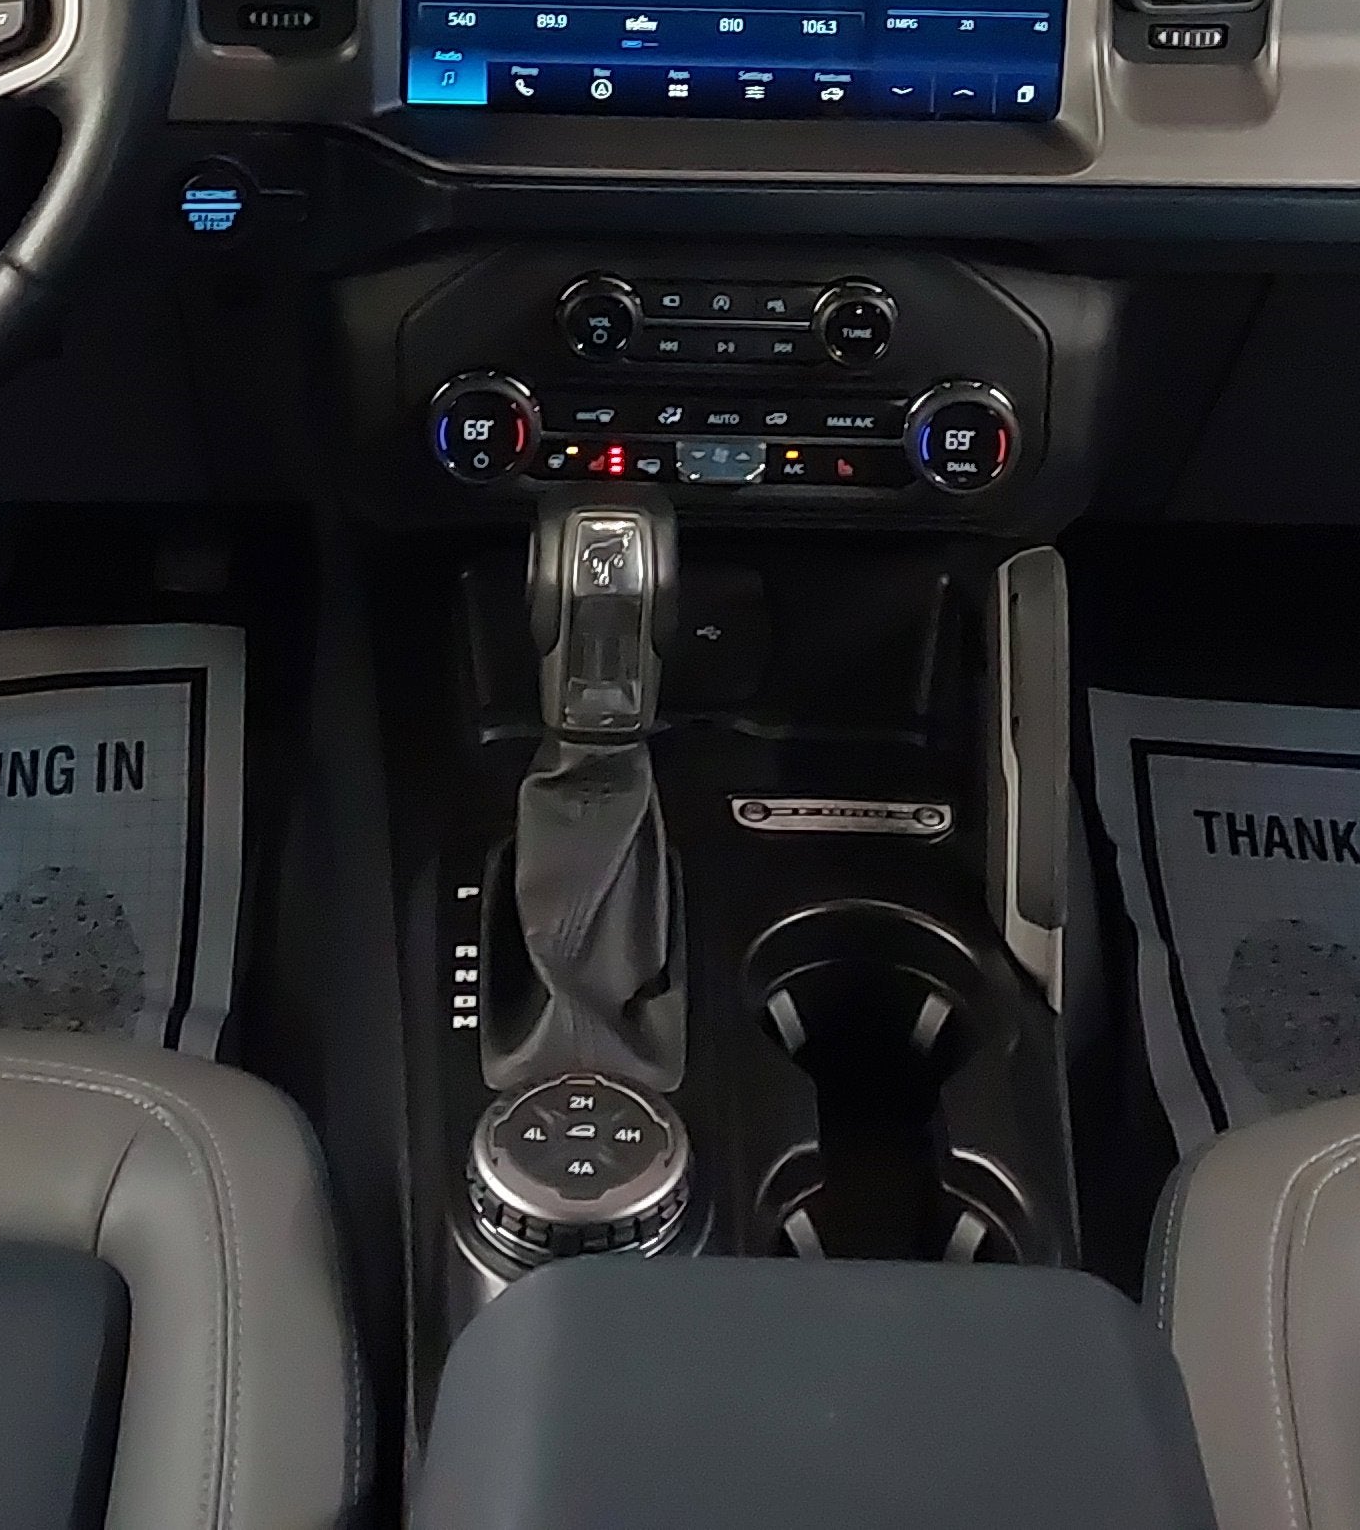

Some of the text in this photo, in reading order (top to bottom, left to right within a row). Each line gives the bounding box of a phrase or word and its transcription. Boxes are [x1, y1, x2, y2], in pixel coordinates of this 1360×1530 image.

[448, 12, 477, 27] 540
[536, 13, 568, 29] 89.9
[719, 18, 744, 32] 810
[959, 19, 975, 31] 20
[801, 20, 838, 35] 106.3
[842, 327, 872, 339] TUNE
[707, 413, 740, 425] AUTO
[854, 416, 875, 428] A/C
[783, 463, 805, 475] A/C
[946, 462, 978, 473] DUAL
[95, 739, 147, 794] IN
[457, 886, 480, 901] P
[568, 1095, 595, 1110] 2H
[523, 1127, 548, 1142] 4L
[614, 1127, 641, 1142] 4H
[566, 1160, 596, 1175] 4A
